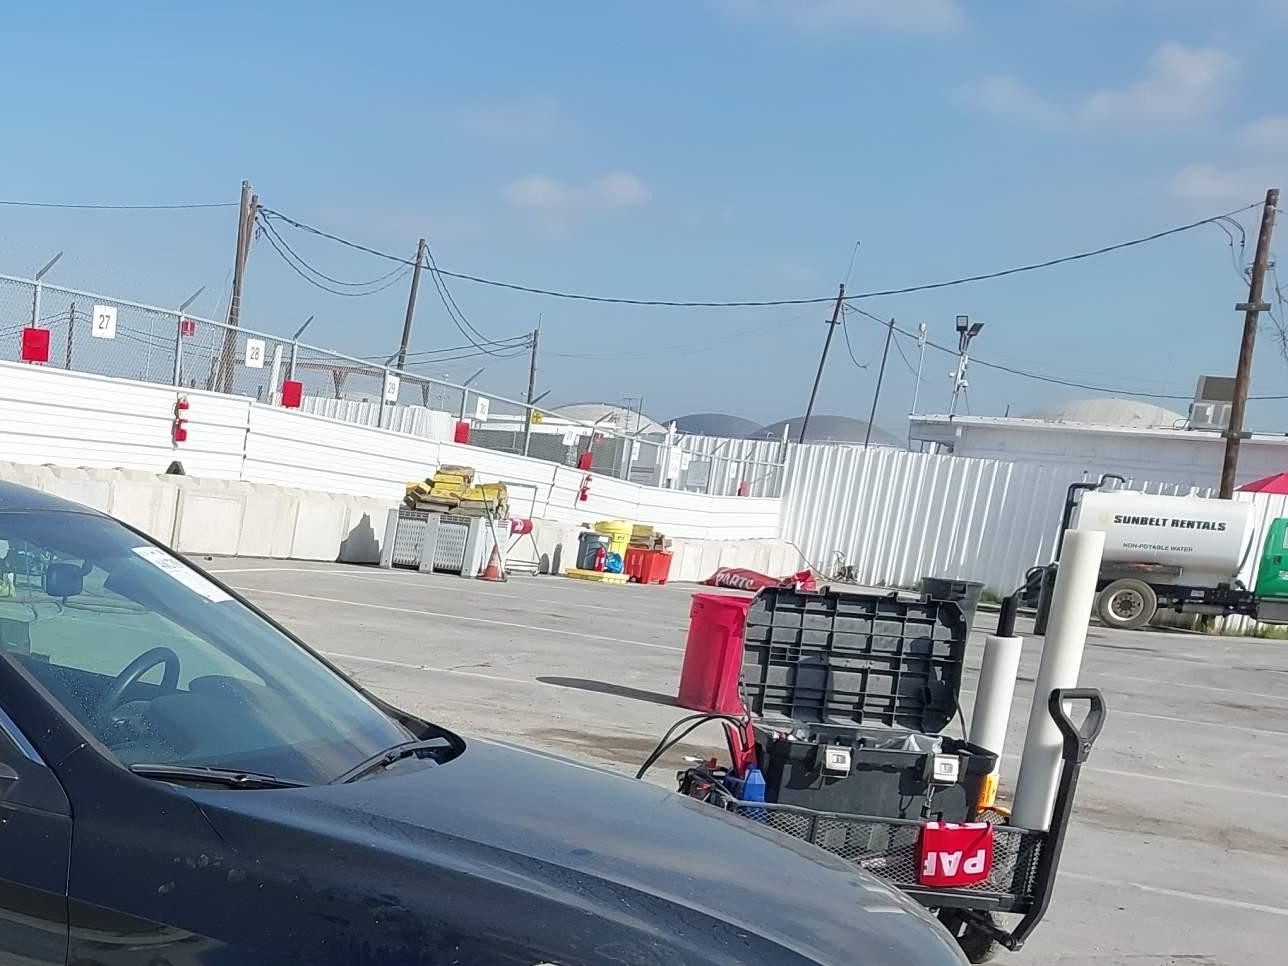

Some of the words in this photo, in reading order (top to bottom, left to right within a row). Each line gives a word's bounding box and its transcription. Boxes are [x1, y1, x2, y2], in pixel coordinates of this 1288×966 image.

[98, 314, 111, 330] 27
[250, 346, 261, 361] 28
[1113, 514, 1169, 527] SUNBELT
[1170, 518, 1227, 531] RENTALS
[1122, 542, 1169, 551] NON-POTABLE
[1170, 545, 1193, 553] WATER
